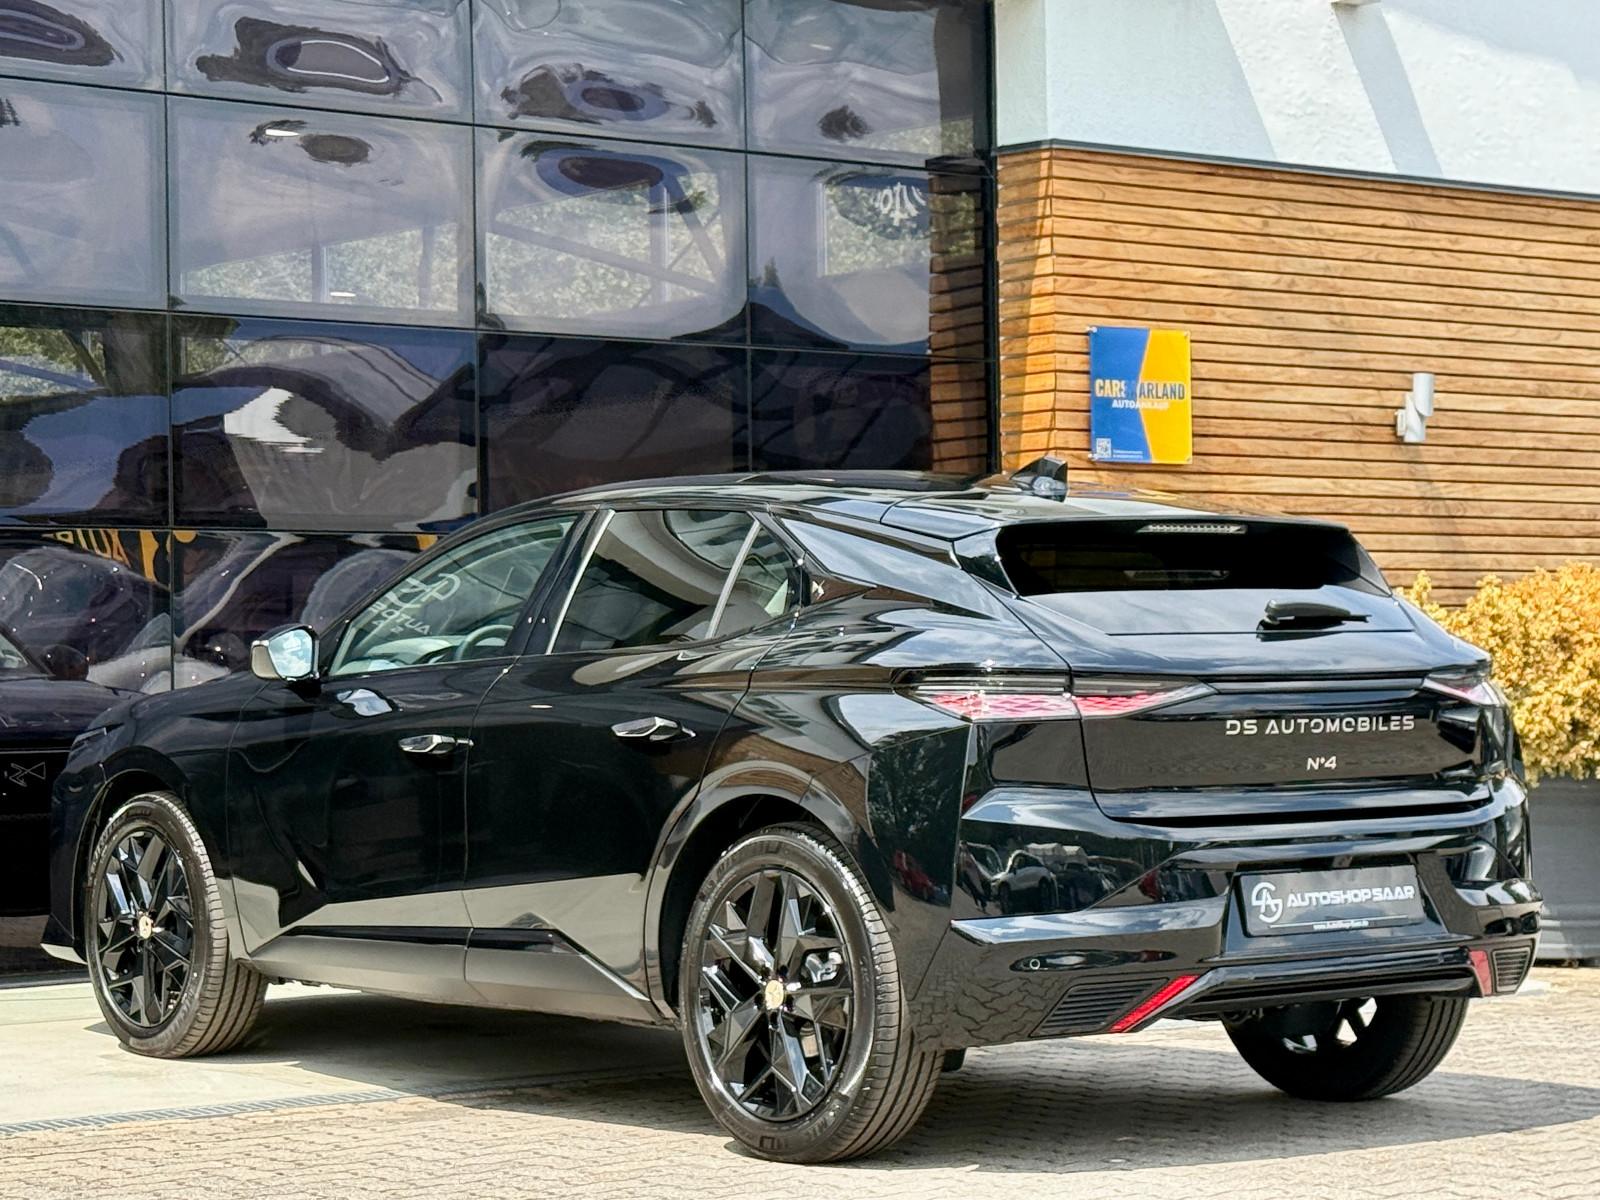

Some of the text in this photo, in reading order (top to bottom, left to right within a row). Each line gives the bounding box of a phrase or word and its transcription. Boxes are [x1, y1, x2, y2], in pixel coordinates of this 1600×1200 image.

[1095, 379, 1185, 399] CARSARLAND
[1225, 715, 1415, 735] DS AUTOMOBILES
